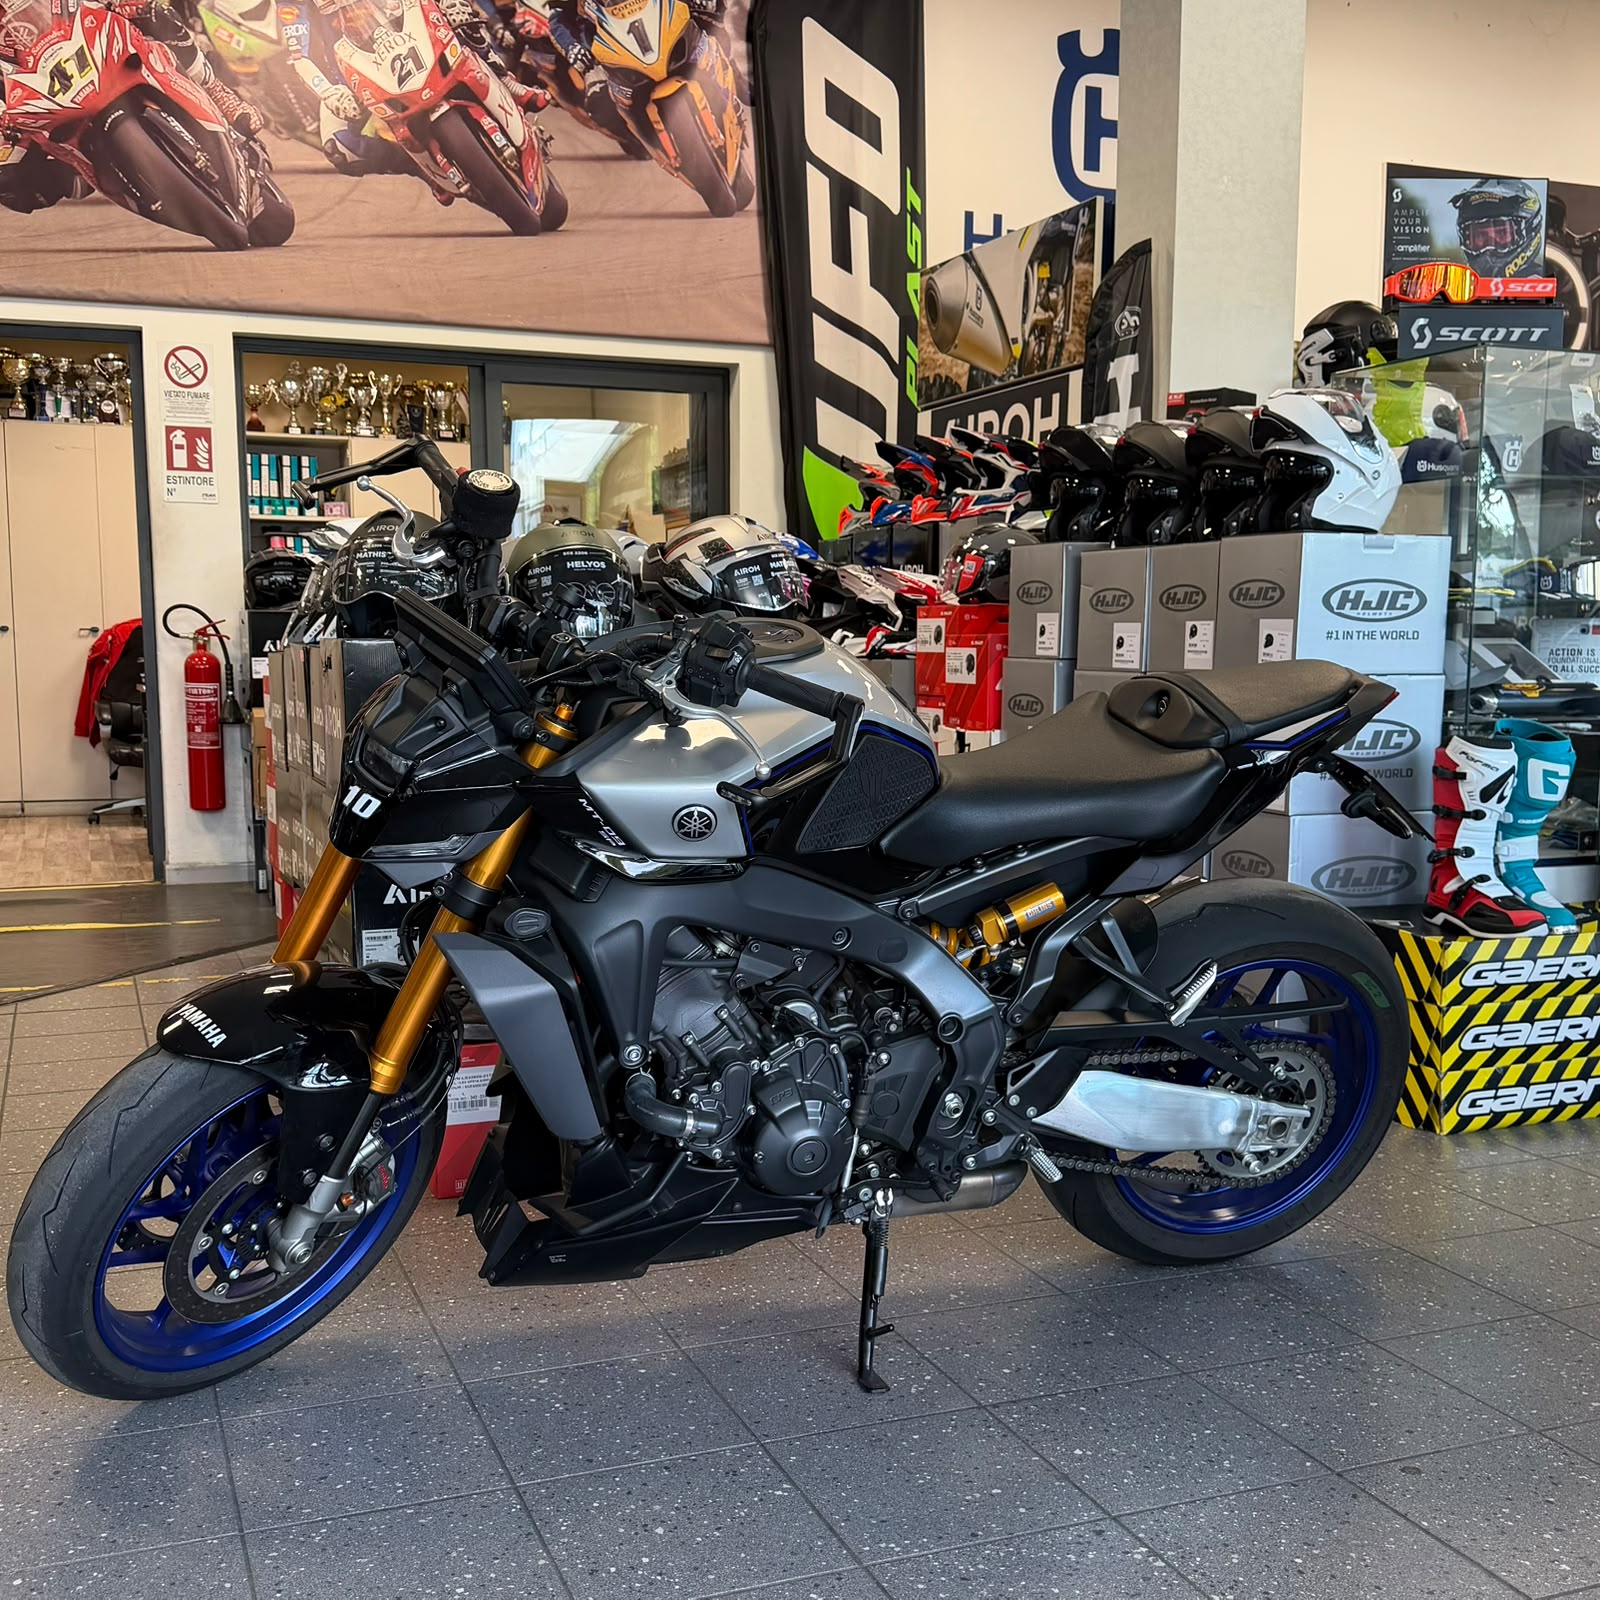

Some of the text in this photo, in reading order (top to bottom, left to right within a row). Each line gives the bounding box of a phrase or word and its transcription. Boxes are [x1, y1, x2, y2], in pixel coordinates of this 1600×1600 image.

[31, 29, 65, 56] Santander
[626, 17, 655, 57] 1
[372, 31, 417, 71] XEROX
[47, 44, 93, 99] 41
[390, 45, 428, 91] 21
[73, 82, 95, 104] YAMAHA
[1394, 217, 1422, 226] YOUR
[1393, 226, 1430, 234] VISION
[802, 16, 902, 468] UFO
[1397, 243, 1430, 253] amplifier
[1435, 326, 1549, 343] SCOTT
[164, 390, 210, 400] VIETATO FUMARE
[166, 475, 215, 486] ESTINTORE
[167, 488, 176, 497] N°
[355, 551, 388, 559] MATHIS
[528, 565, 552, 576] AIROH
[566, 561, 607, 569] HELYOS
[734, 565, 761, 577] AIROH
[1021, 586, 1049, 599] HJC
[1165, 591, 1200, 606] HJC
[1235, 586, 1277, 601] HJC
[1095, 594, 1128, 608] HJC
[1335, 590, 1415, 611] HJC
[1326, 630, 1420, 640] #1 IN THE WORLD
[1548, 648, 1596, 657] ACTION IS
[1560, 665, 1575, 673] ALL
[1013, 699, 1039, 712] HJC
[1374, 767, 1414, 779] WORLD
[342, 785, 382, 819] 10
[578, 798, 626, 846] MT-09
[1229, 855, 1267, 875] HJC
[1325, 865, 1404, 888] HJC
[177, 1002, 227, 1049] YAMAHA
